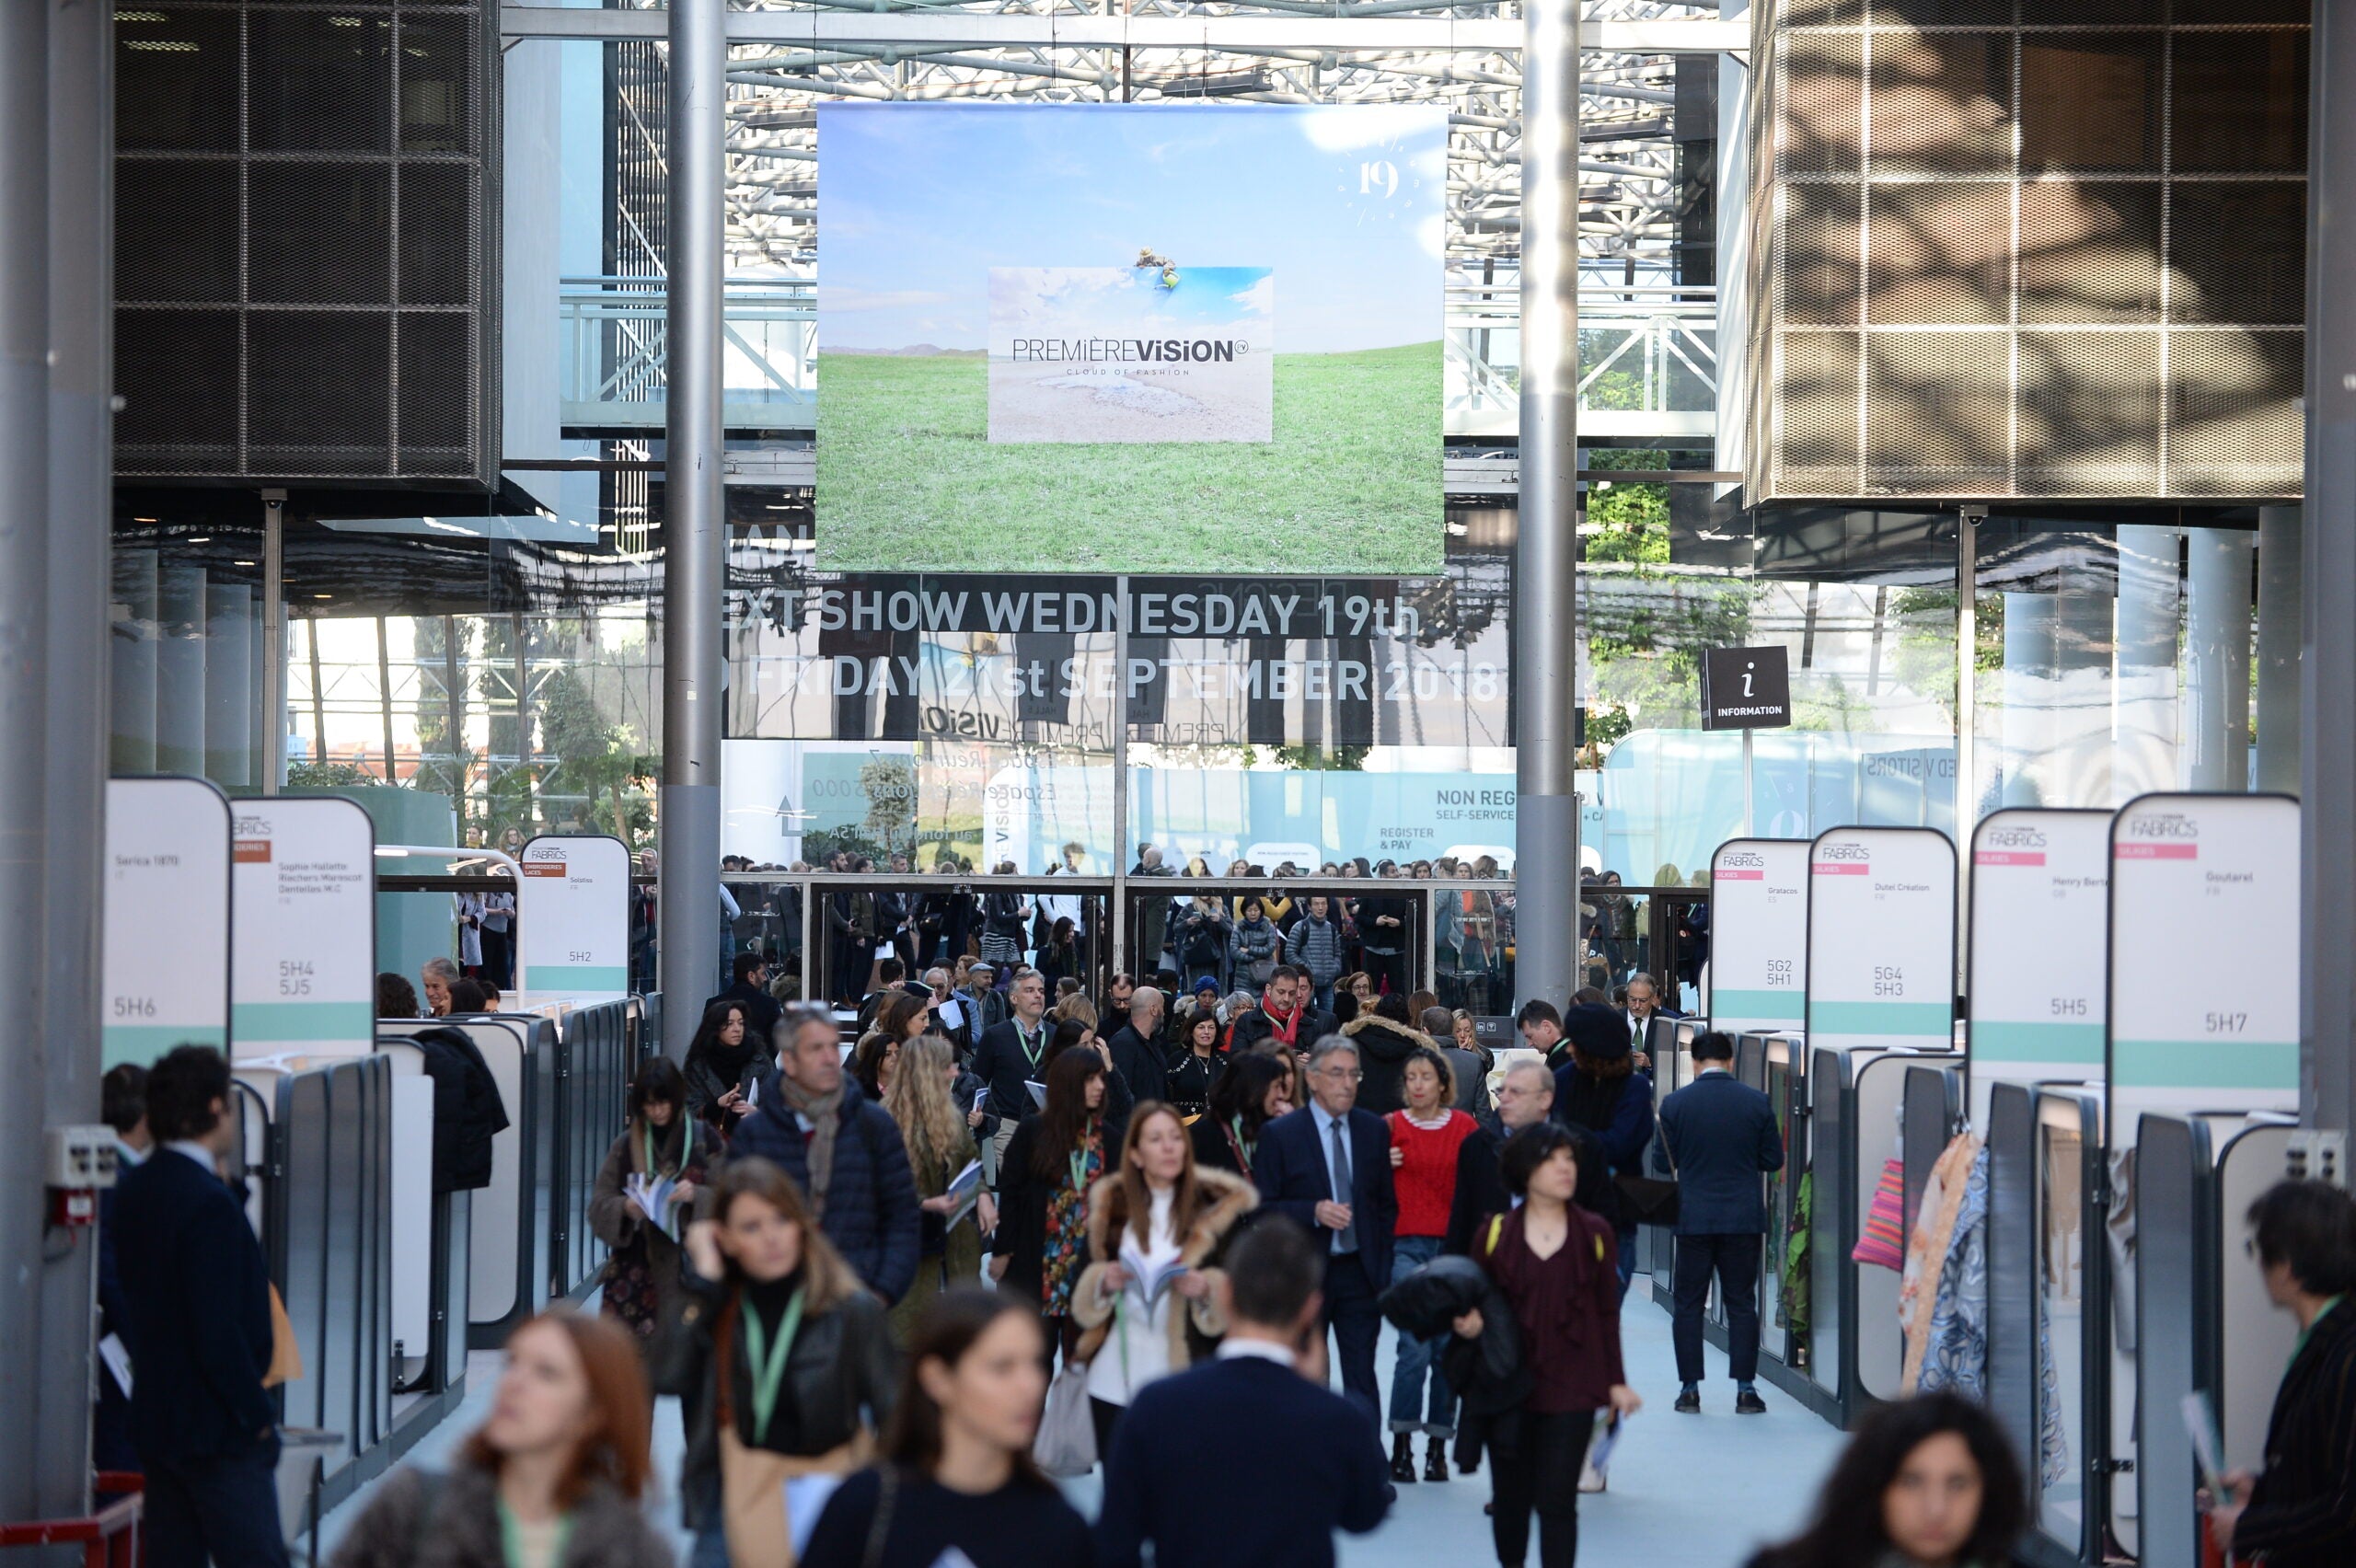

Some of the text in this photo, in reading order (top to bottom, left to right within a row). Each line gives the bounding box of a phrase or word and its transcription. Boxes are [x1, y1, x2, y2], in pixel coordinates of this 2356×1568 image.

[1359, 159, 1399, 200] 19
[820, 590, 968, 632] SHOW
[982, 592, 1300, 635] WEDNESDAY
[1318, 594, 1419, 637] 19th
[749, 655, 926, 697] FRIDAY
[944, 658, 1045, 698] 21st
[1059, 658, 1369, 700] SEPTEMBER
[1384, 661, 1498, 701] 2018
[1717, 705, 1783, 718] INFORMATION
[1437, 790, 1516, 806] NON REG
[1436, 810, 1515, 821] SELF-SERVICE
[1380, 827, 1434, 838] REGISTER
[1380, 839, 1412, 850] & PAY
[278, 862, 308, 872] Sophie
[1875, 883, 1894, 892] Dutel
[2052, 876, 2081, 889] Henry
[1768, 887, 1798, 895] Gratacos
[569, 951, 592, 962] 5H2
[279, 961, 315, 976] 5H4
[1767, 960, 1792, 973] 5G2
[1767, 974, 1791, 986] 5H1
[1874, 967, 1902, 980] 5G4
[279, 980, 310, 995] 5J5
[1874, 983, 1903, 997] 5H3
[114, 997, 156, 1017] 5H6
[2050, 998, 2087, 1016] 5H5
[2205, 1013, 2247, 1032] 5H7
